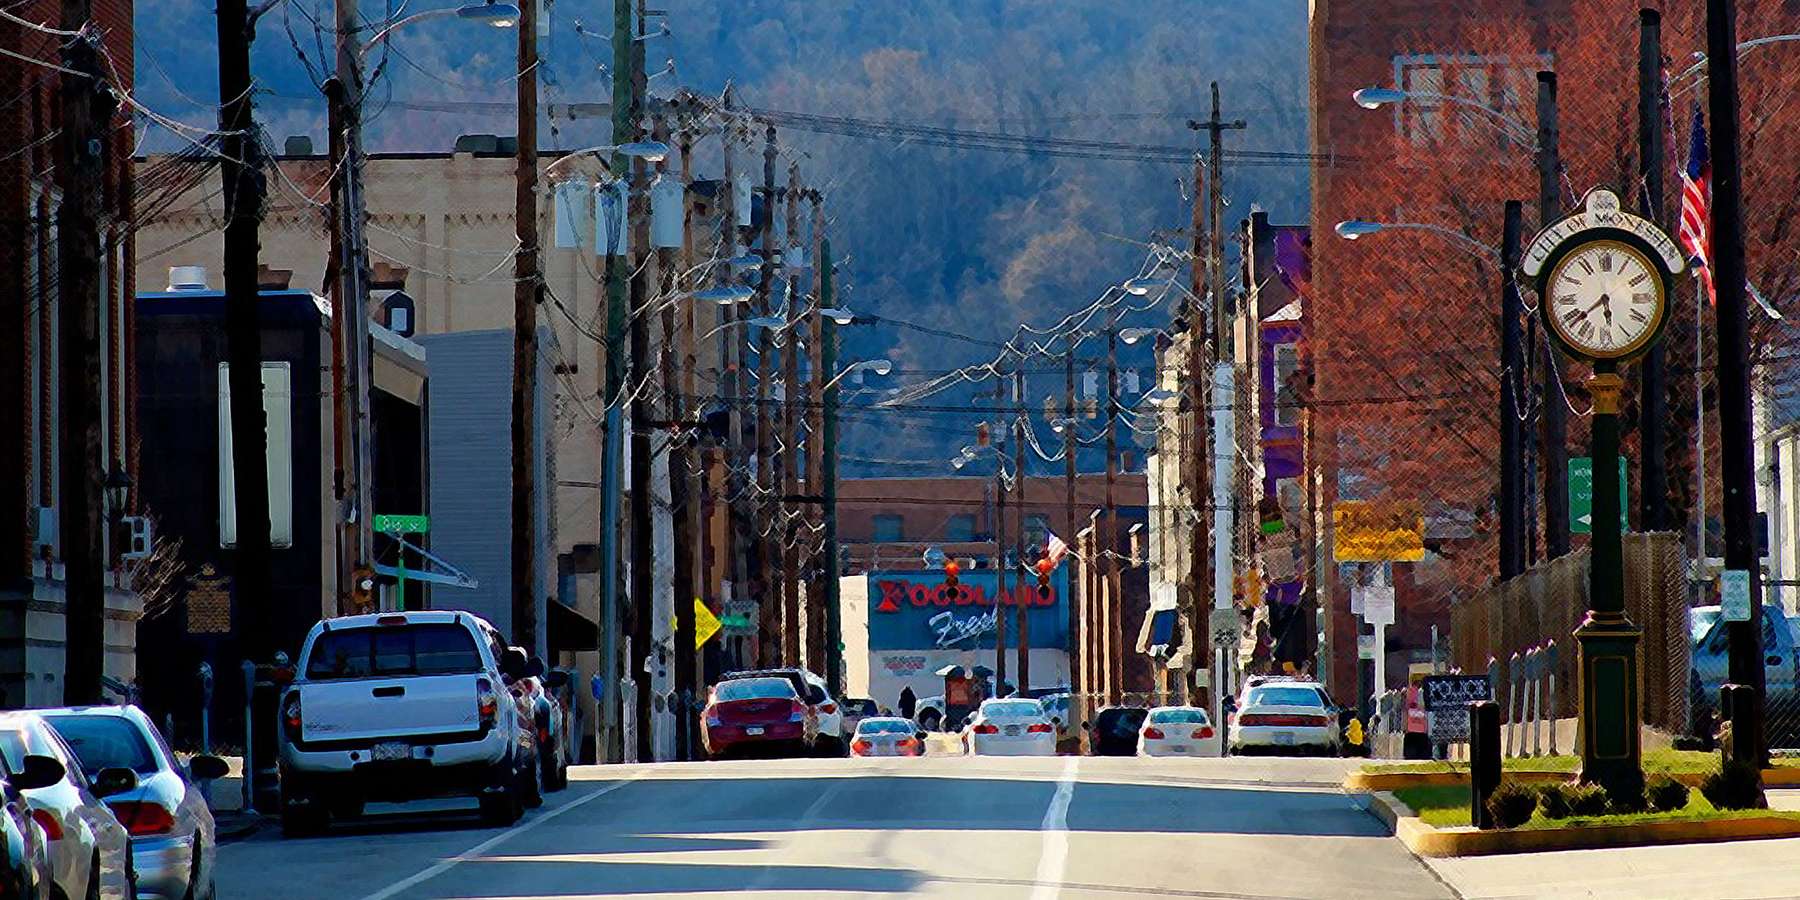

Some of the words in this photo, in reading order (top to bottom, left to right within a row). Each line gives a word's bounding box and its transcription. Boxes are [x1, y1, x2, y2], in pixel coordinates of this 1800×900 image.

[1534, 226, 1565, 262] CITY
[1567, 216, 1587, 233] OF
[929, 607, 1002, 648] Fresh
[1428, 679, 1487, 699] POLICE
